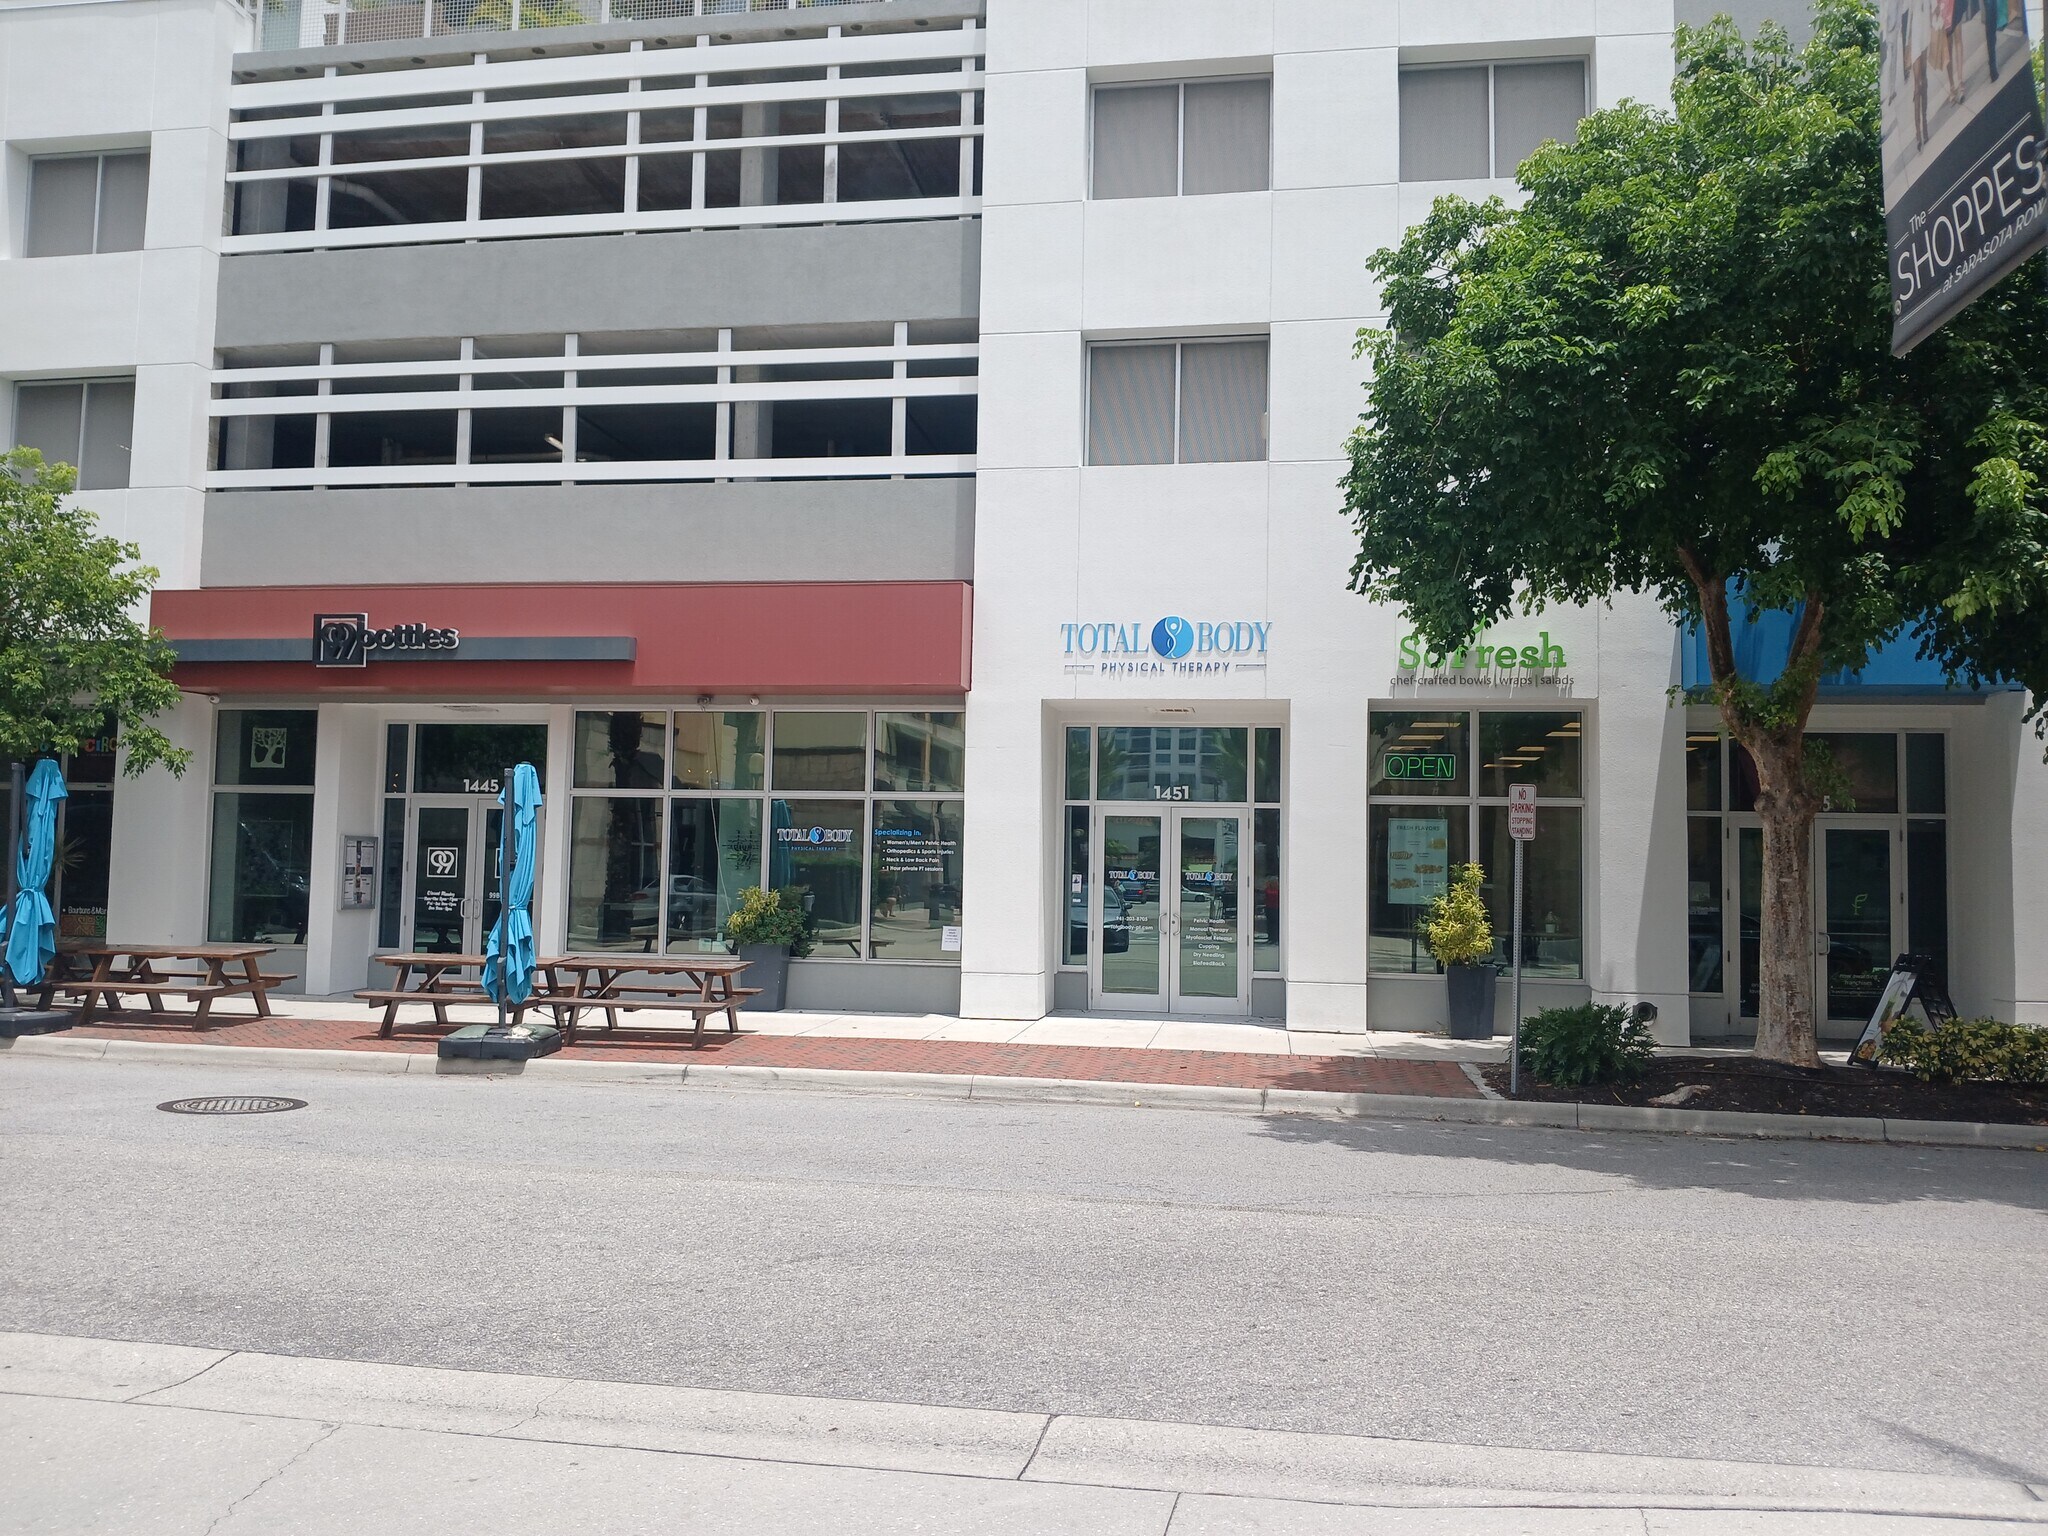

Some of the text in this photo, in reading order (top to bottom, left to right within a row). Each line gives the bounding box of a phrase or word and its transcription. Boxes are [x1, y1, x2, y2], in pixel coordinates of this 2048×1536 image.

[1897, 135, 2044, 301] SHOPPES
[1908, 210, 1927, 234] The
[1942, 197, 2047, 293] at SARASOTA ROW
[358, 623, 460, 650] bottles
[1060, 621, 1273, 653] TOTAL BODY
[1101, 662, 1231, 673] PHYSICAL THERAPY
[1390, 674, 1575, 689] chef-crafted bowls wraps salads
[1387, 756, 1452, 777] OPEN
[463, 778, 499, 792] 1445
[1153, 785, 1189, 800] 1451
[1518, 789, 1527, 800] NO
[1511, 803, 1534, 813] PARKING
[1511, 817, 1533, 825] STOPPING
[777, 828, 853, 842] TOTAL BODY
[874, 829, 913, 837] Specializing
[1511, 827, 1533, 835] STANDING
[430, 850, 455, 874] 99
[1109, 870, 1156, 880] TOTAL BODY
[1185, 872, 1233, 881] TOTAL BODY
